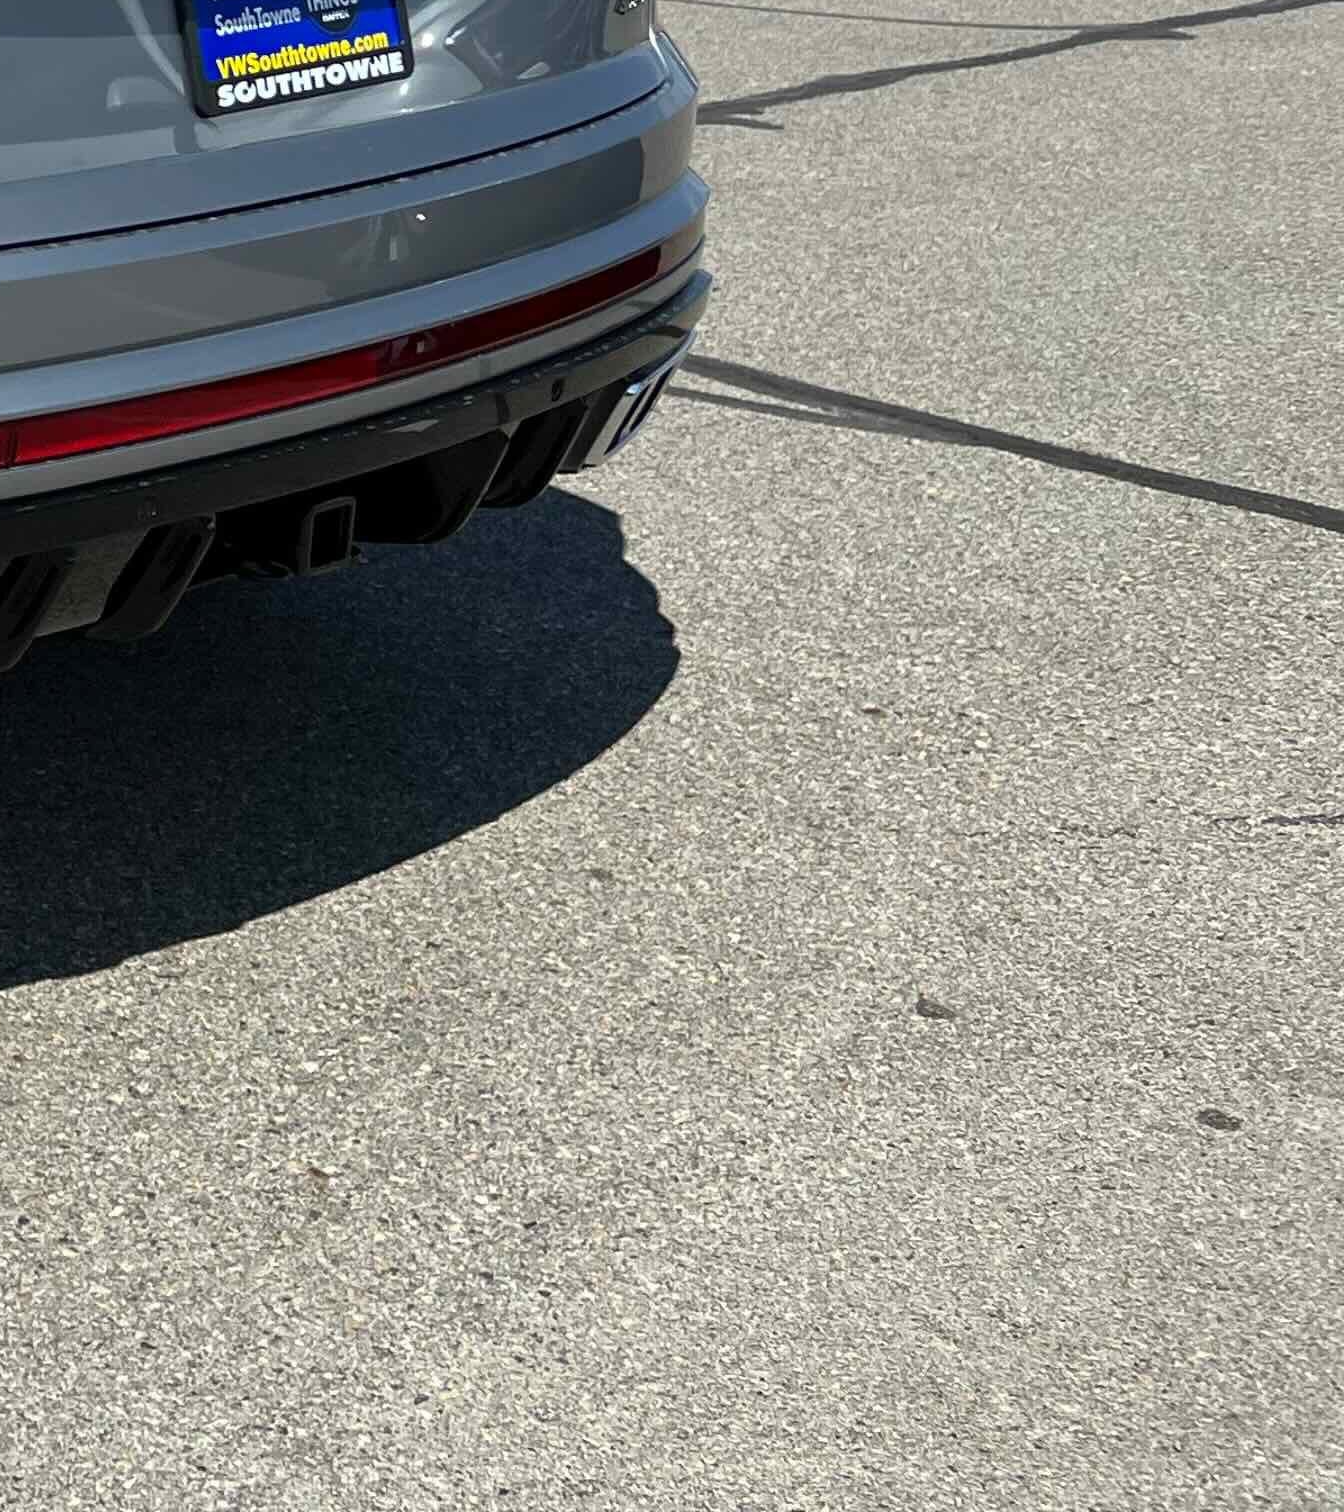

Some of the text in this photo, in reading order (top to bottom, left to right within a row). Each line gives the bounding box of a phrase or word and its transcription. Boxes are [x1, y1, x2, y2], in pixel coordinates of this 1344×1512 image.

[214, 4, 302, 37] SouthTowne
[215, 31, 389, 80] VWSouthtowne.com
[217, 51, 404, 108] SOUTHTOWNE
